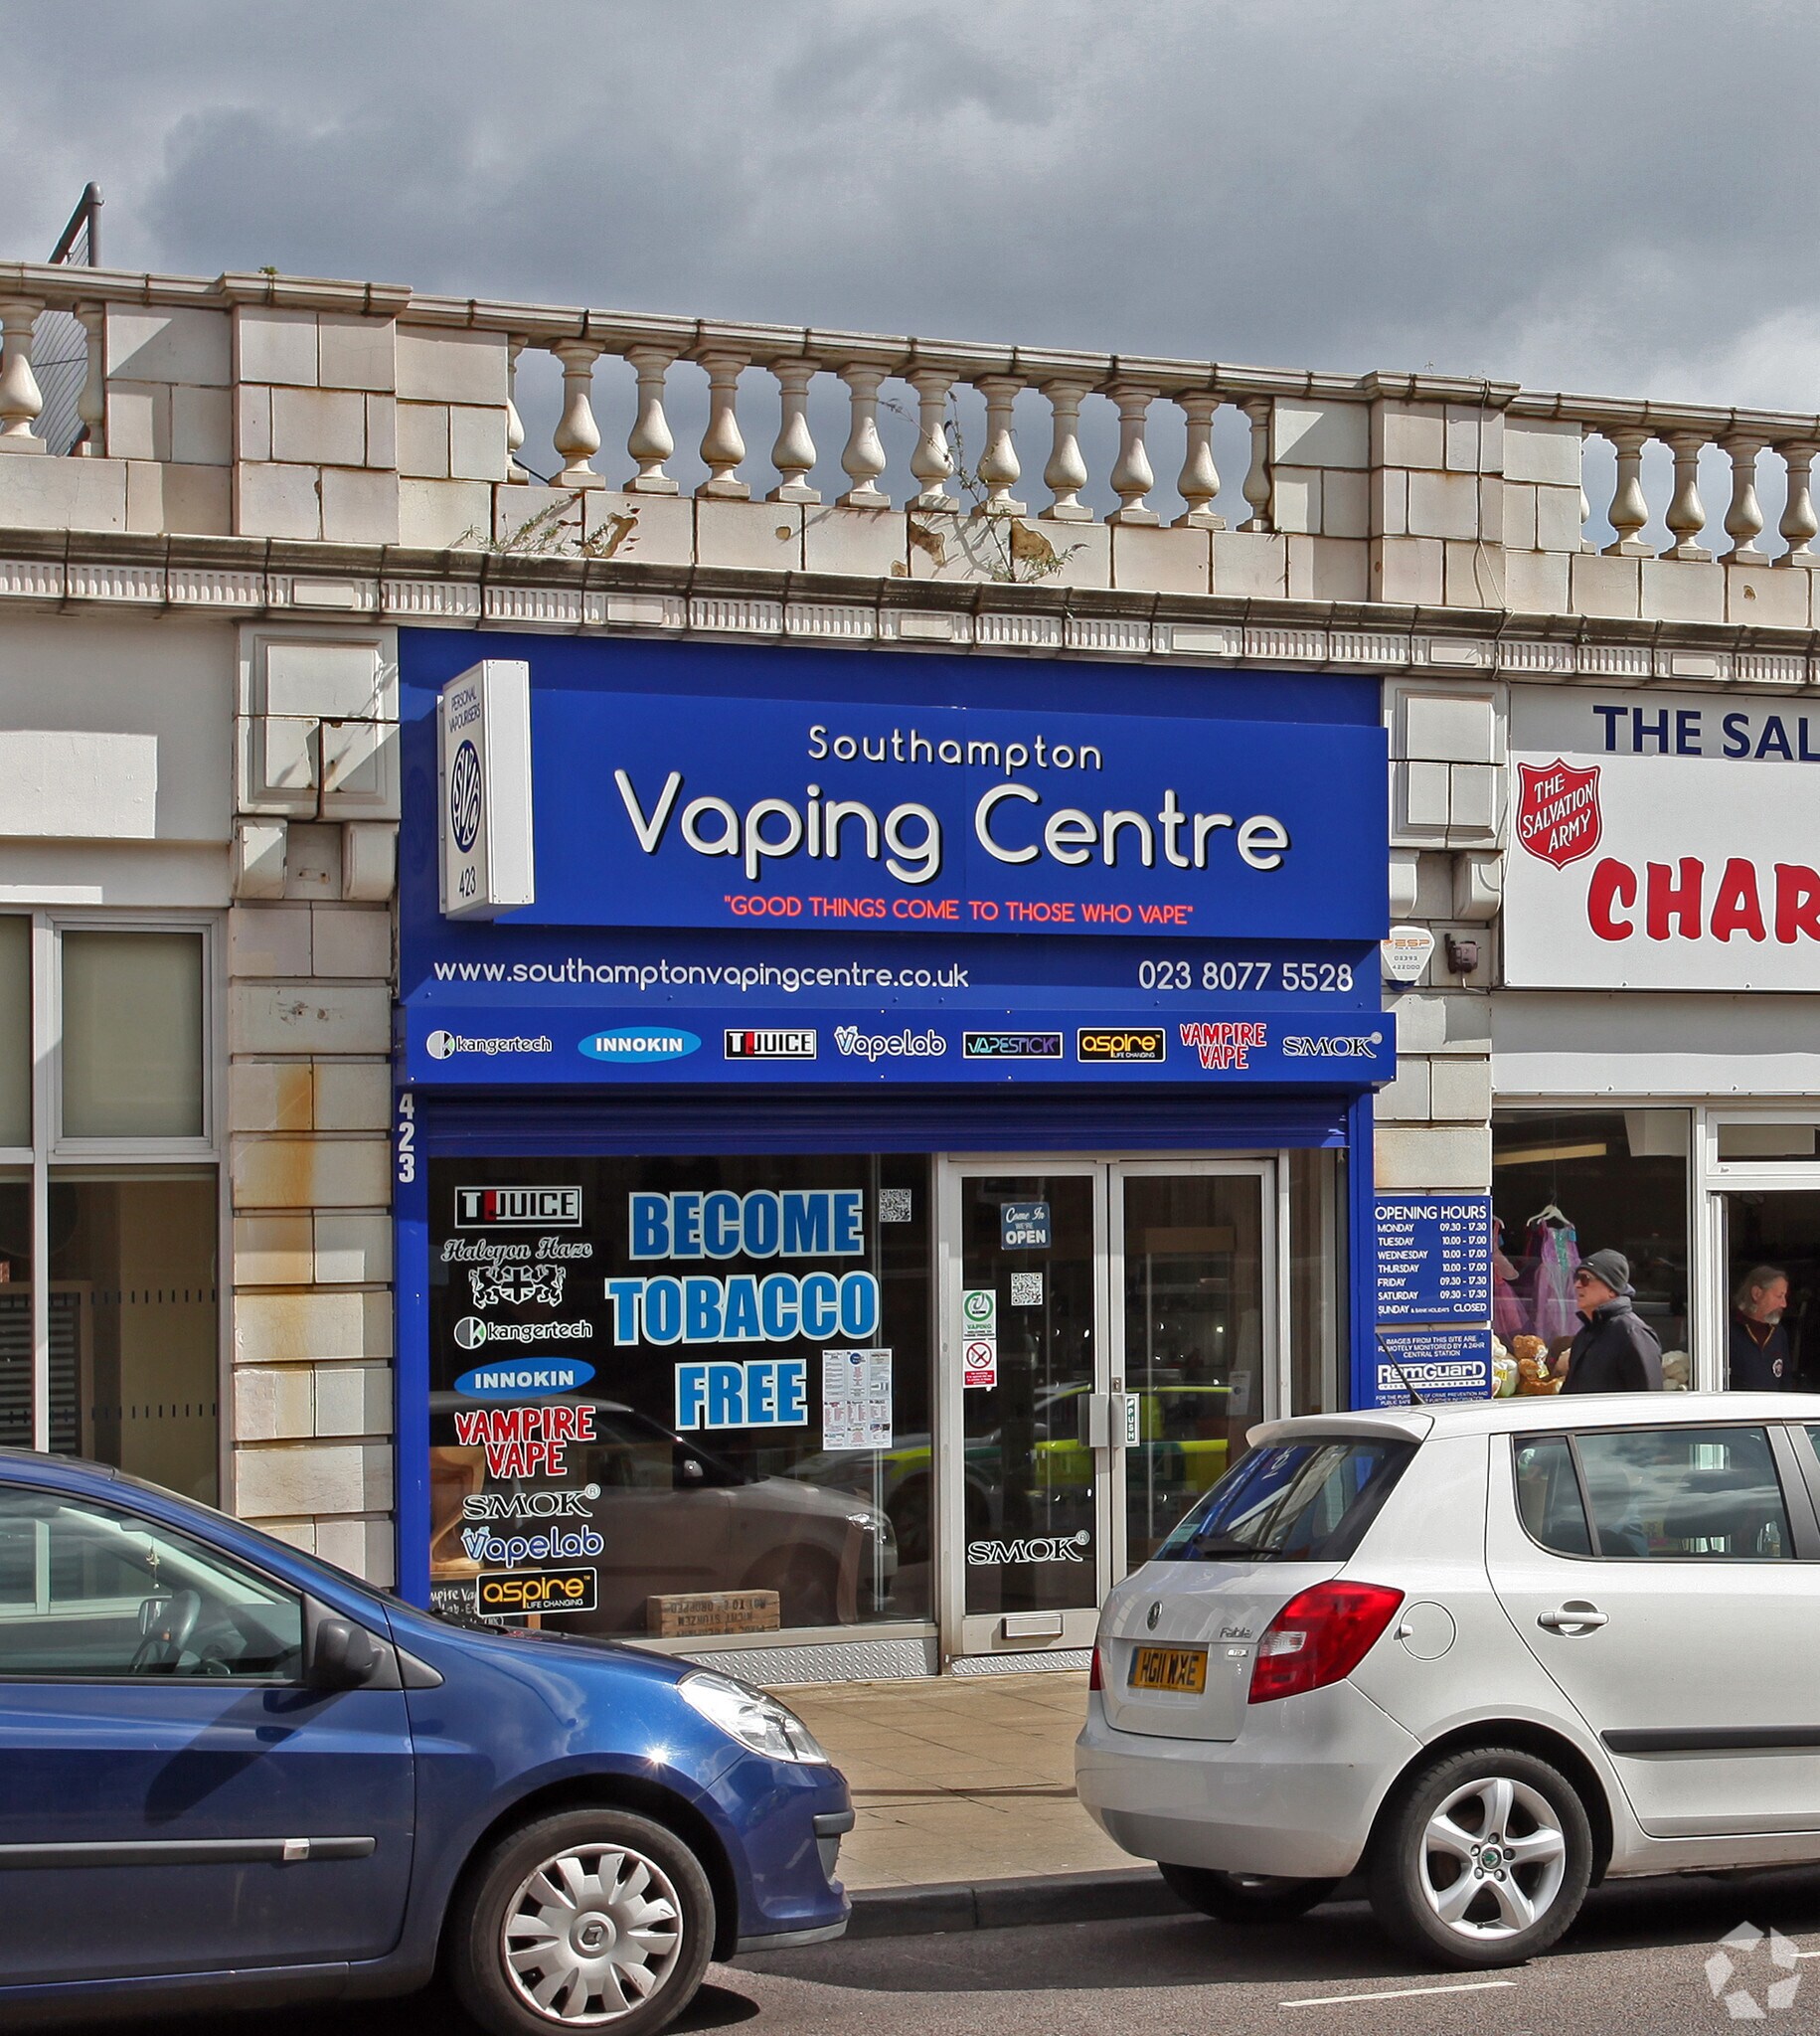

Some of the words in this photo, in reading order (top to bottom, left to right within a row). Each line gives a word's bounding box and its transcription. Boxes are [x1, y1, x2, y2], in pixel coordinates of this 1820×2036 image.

[450, 685, 477, 714] PERSONAL
[449, 703, 480, 734] VAPOURISERS
[1592, 705, 1702, 756] THE
[1722, 712, 1820, 762] SAL
[808, 725, 1102, 775] Southampton
[1534, 773, 1566, 803] THE
[1522, 778, 1593, 838] SALVATION
[614, 768, 940, 884] Vaping
[974, 783, 1289, 870] Centre
[1548, 808, 1591, 854] ARMY
[459, 866, 476, 898] 423
[724, 896, 802, 918] "GOOD
[808, 897, 887, 919] THINGS
[893, 899, 959, 920] COME
[968, 901, 999, 921] TO
[1005, 902, 1075, 923] THOSE
[1081, 904, 1132, 924] WHO
[1138, 905, 1194, 925] VAPE"
[1587, 857, 1820, 943] CHAR
[433, 957, 969, 992] www.southamptonvapingcentre.co.uk
[1139, 960, 1192, 990] 023
[1202, 961, 1272, 991] 8077
[1282, 963, 1354, 992] 5528
[456, 1035, 553, 1056] kangertech
[596, 1037, 683, 1052] INNOKIN
[967, 1037, 1059, 1055] VAPESTICK
[1180, 1022, 1267, 1047] VAMPIRE
[1199, 1044, 1249, 1070] VAPE
[399, 1094, 414, 1183] 423
[629, 1189, 864, 1260] BECOME
[1006, 1207, 1030, 1223] Come
[1032, 1206, 1046, 1221] In
[1375, 1206, 1437, 1220] OPENING
[1440, 1206, 1487, 1220] HOURS
[1005, 1229, 1047, 1245] OPEN
[1378, 1224, 1414, 1233] MONDAY
[1378, 1237, 1414, 1246] TUESDAY
[440, 1239, 531, 1266] Halcyon
[535, 1237, 593, 1260] Haze
[1378, 1251, 1428, 1260] WEDNESDAY
[1378, 1264, 1419, 1272] THURSDAY
[1378, 1277, 1406, 1286] FRIDAY
[604, 1271, 880, 1346] TOBACCO
[1378, 1291, 1418, 1300] SATURDAY
[1378, 1305, 1409, 1314] SUNDAY
[1453, 1303, 1487, 1312] CLOSED
[487, 1319, 592, 1344] kangertech
[474, 1370, 575, 1389] INNOKIN
[675, 1358, 808, 1431] FREE
[454, 1405, 596, 1445] VAMPIRE
[486, 1441, 568, 1479] VAPE
[526, 1600, 542, 1610] LIFE
[544, 1598, 583, 1609] CHANGING
